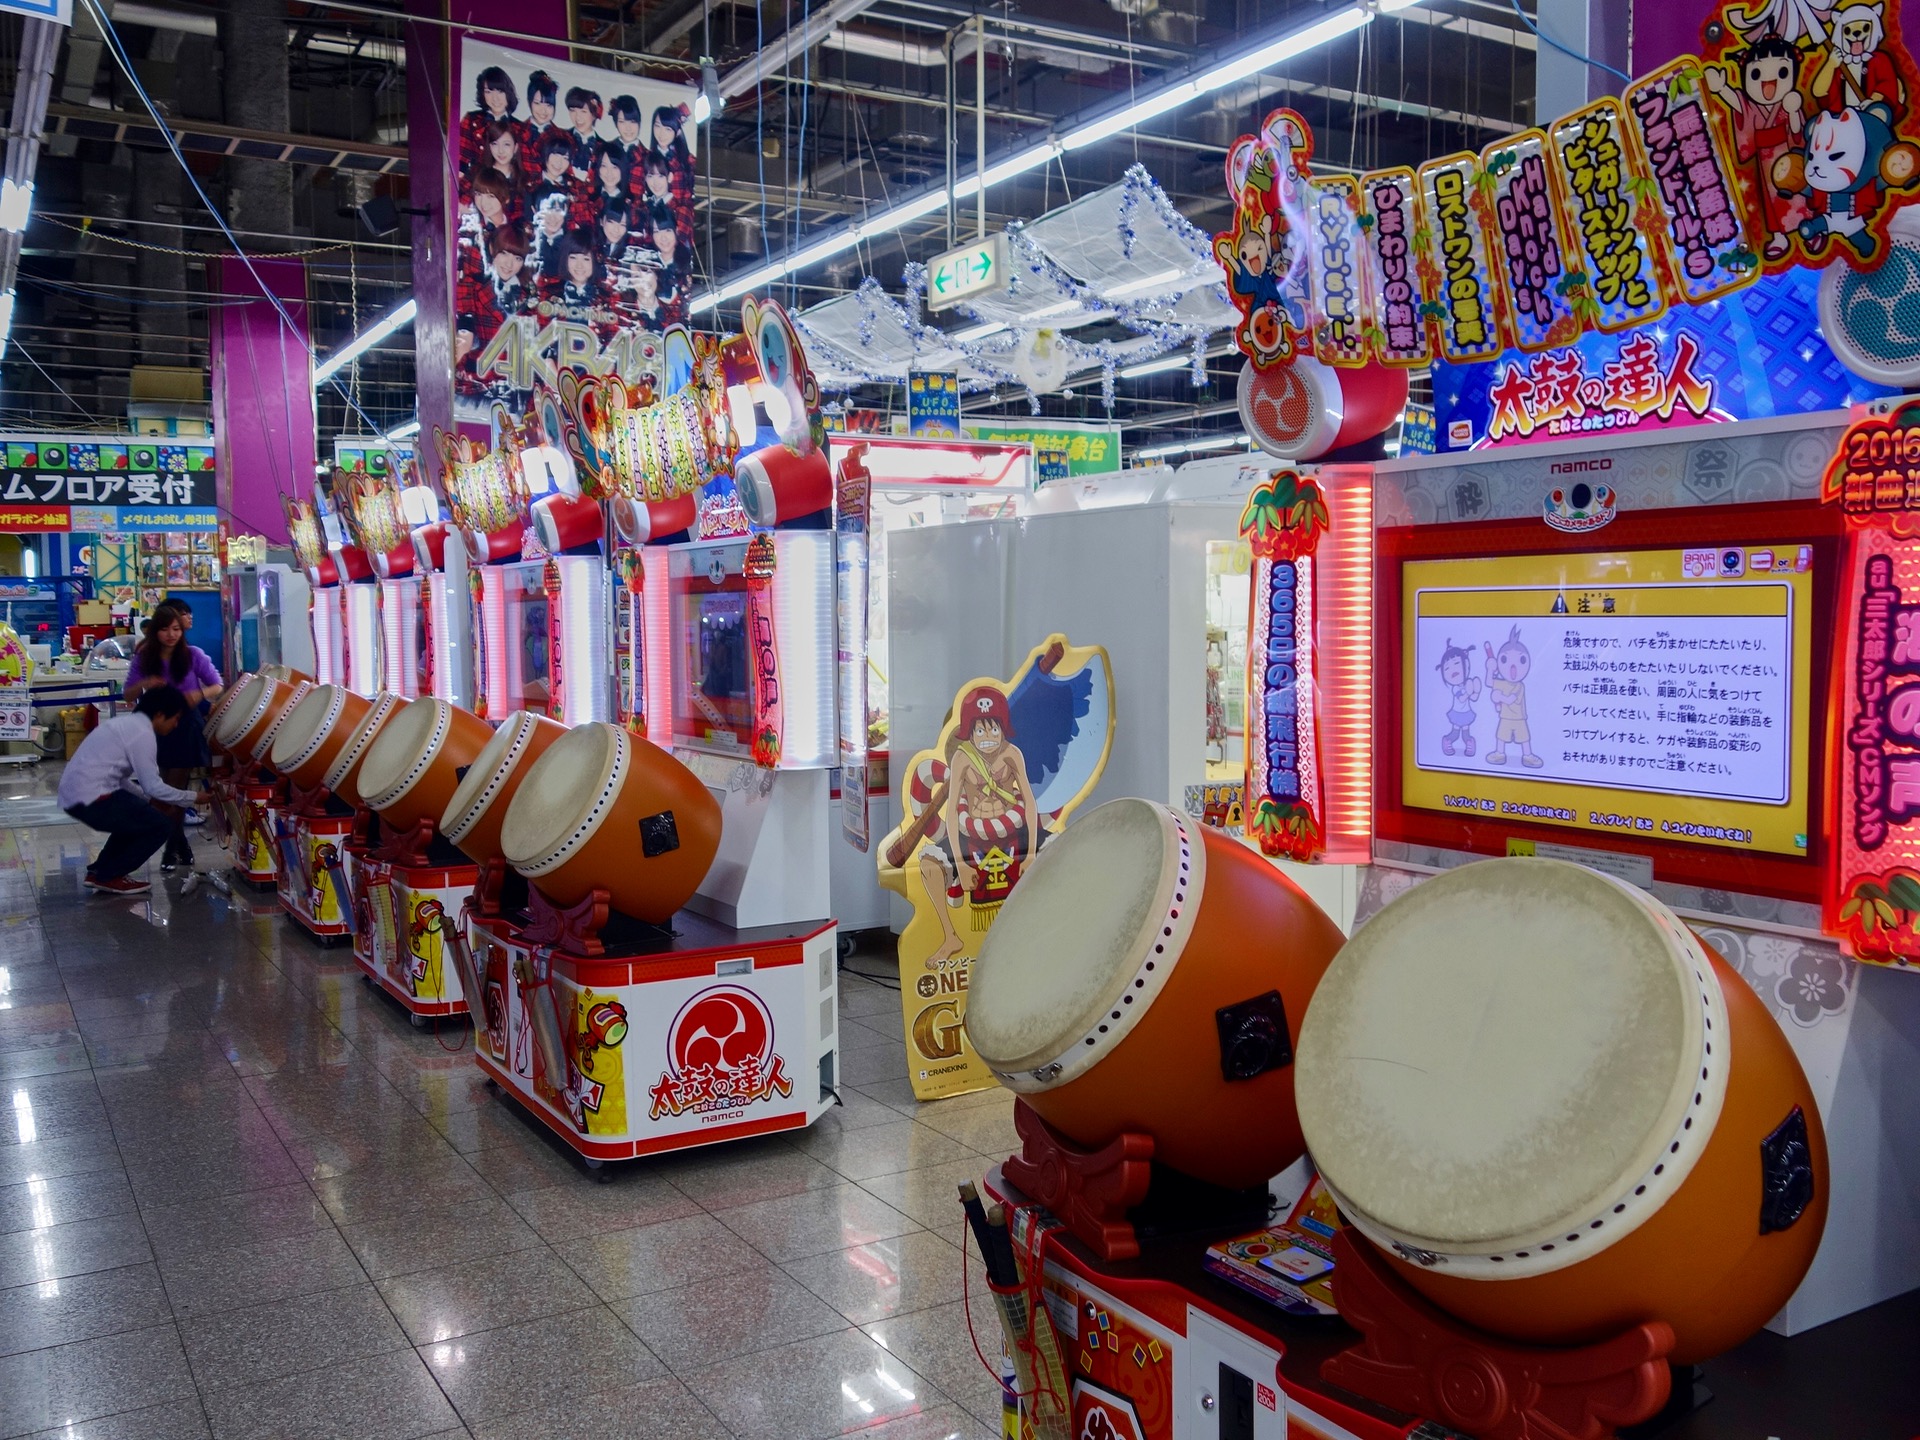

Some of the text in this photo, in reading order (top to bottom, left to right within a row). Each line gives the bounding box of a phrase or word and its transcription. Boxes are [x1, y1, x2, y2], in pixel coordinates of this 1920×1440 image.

[1583, 119, 1650, 308] シュガーソングと
[1637, 94, 1714, 279] フランドール・S
[1671, 100, 1738, 248] 最終鬼畜妹
[1497, 197, 1532, 313] Days
[1511, 176, 1553, 325] Knock
[1523, 156, 1559, 277] Hard
[1564, 137, 1623, 304] ビターステップ
[1373, 184, 1417, 351] ひまわりの約束
[477, 314, 665, 398] AKB48
[1490, 333, 1712, 440] 太鼓の達人
[922, 398, 949, 407] UFO
[1549, 411, 1640, 435] たいこのたつじん
[1551, 458, 1612, 475] namco
[1849, 426, 1920, 467] 2016
[0, 474, 195, 504] ムフロア受付
[1684, 553, 1715, 562] BANA
[1577, 597, 1616, 614] 注意
[1266, 563, 1299, 797] 365日の紙飛行機
[650, 1053, 792, 1121] 太鼓の達人
[928, 1063, 968, 1077] CRANEKING
[702, 1110, 744, 1123] namco
